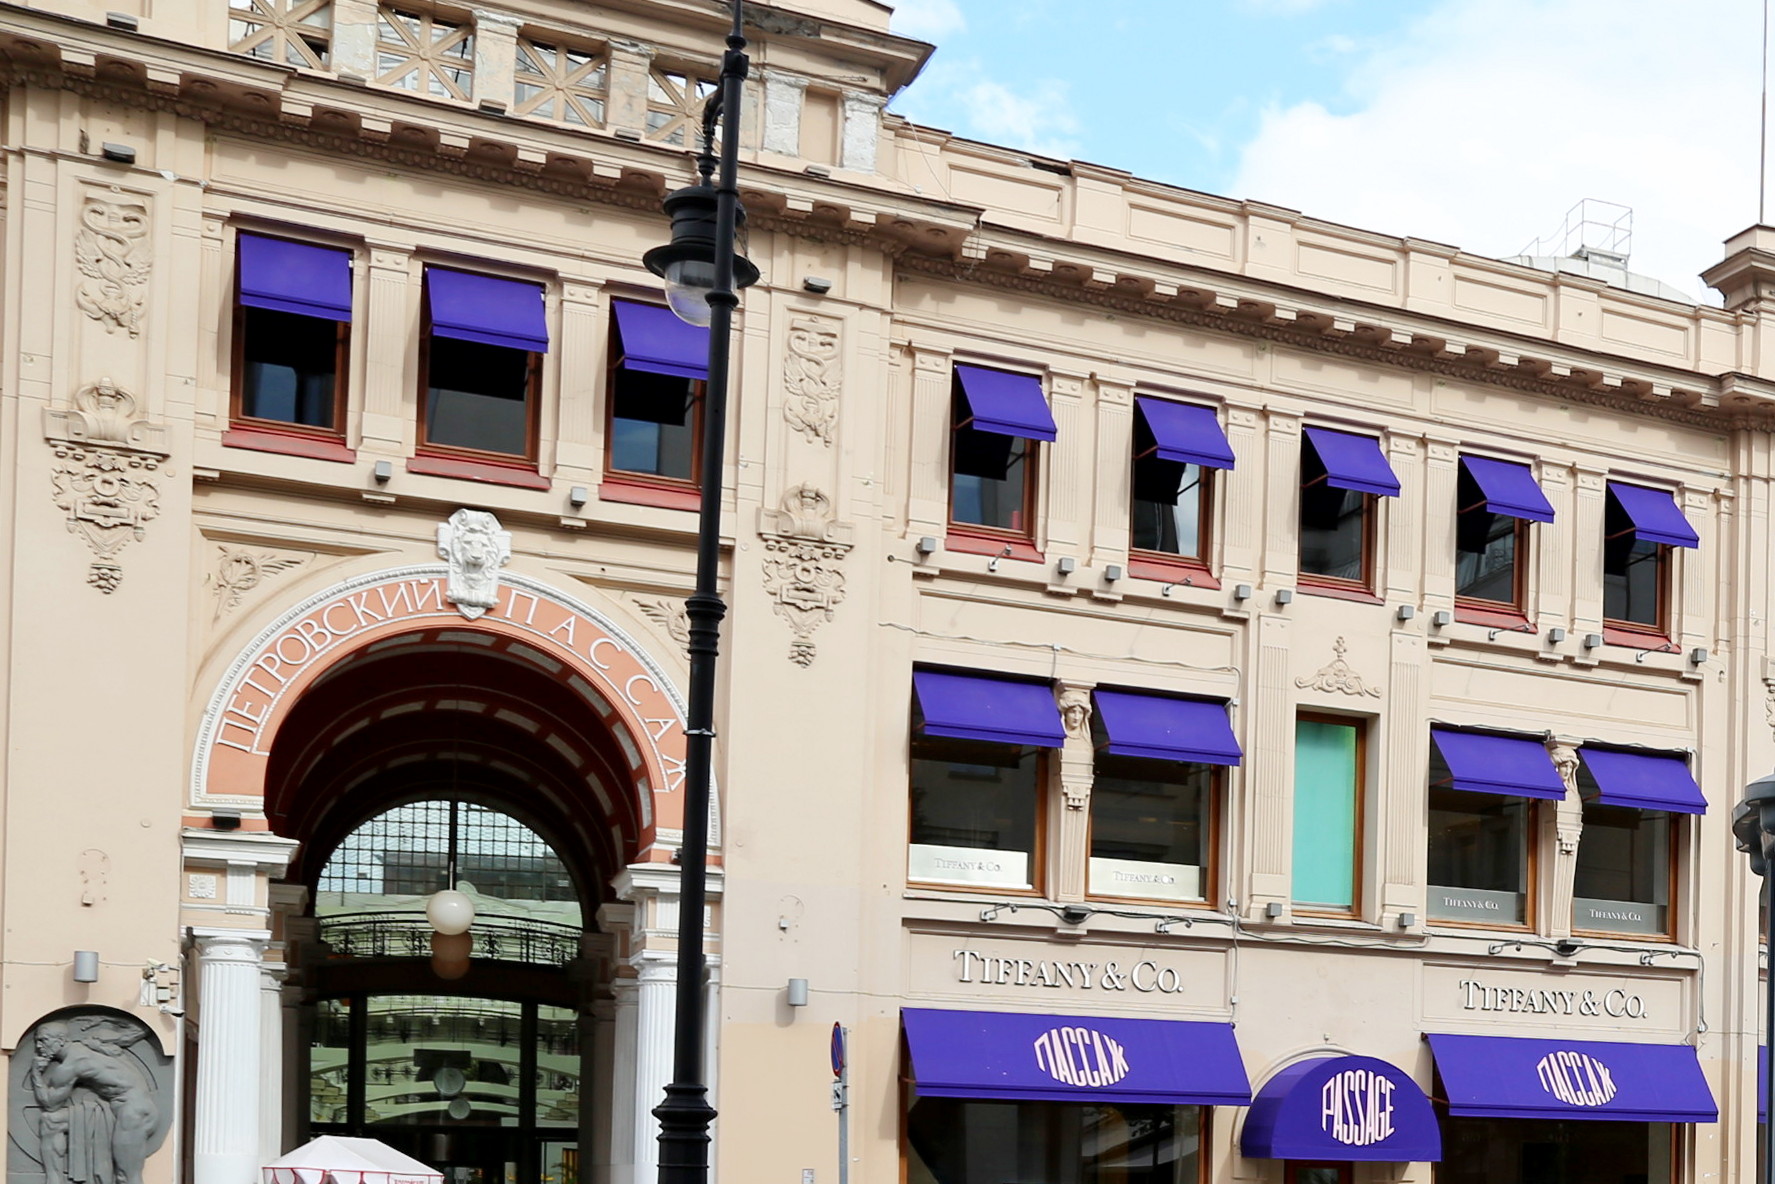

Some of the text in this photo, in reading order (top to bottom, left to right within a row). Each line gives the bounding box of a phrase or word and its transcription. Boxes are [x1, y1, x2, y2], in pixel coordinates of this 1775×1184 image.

[215, 578, 444, 754] ПЕТРОВСКИЙ
[1033, 1026, 1129, 1087] ПАССАЖ
[1536, 1050, 1618, 1107] ПАССАЖ
[1321, 1068, 1396, 1146] PASSAGE
